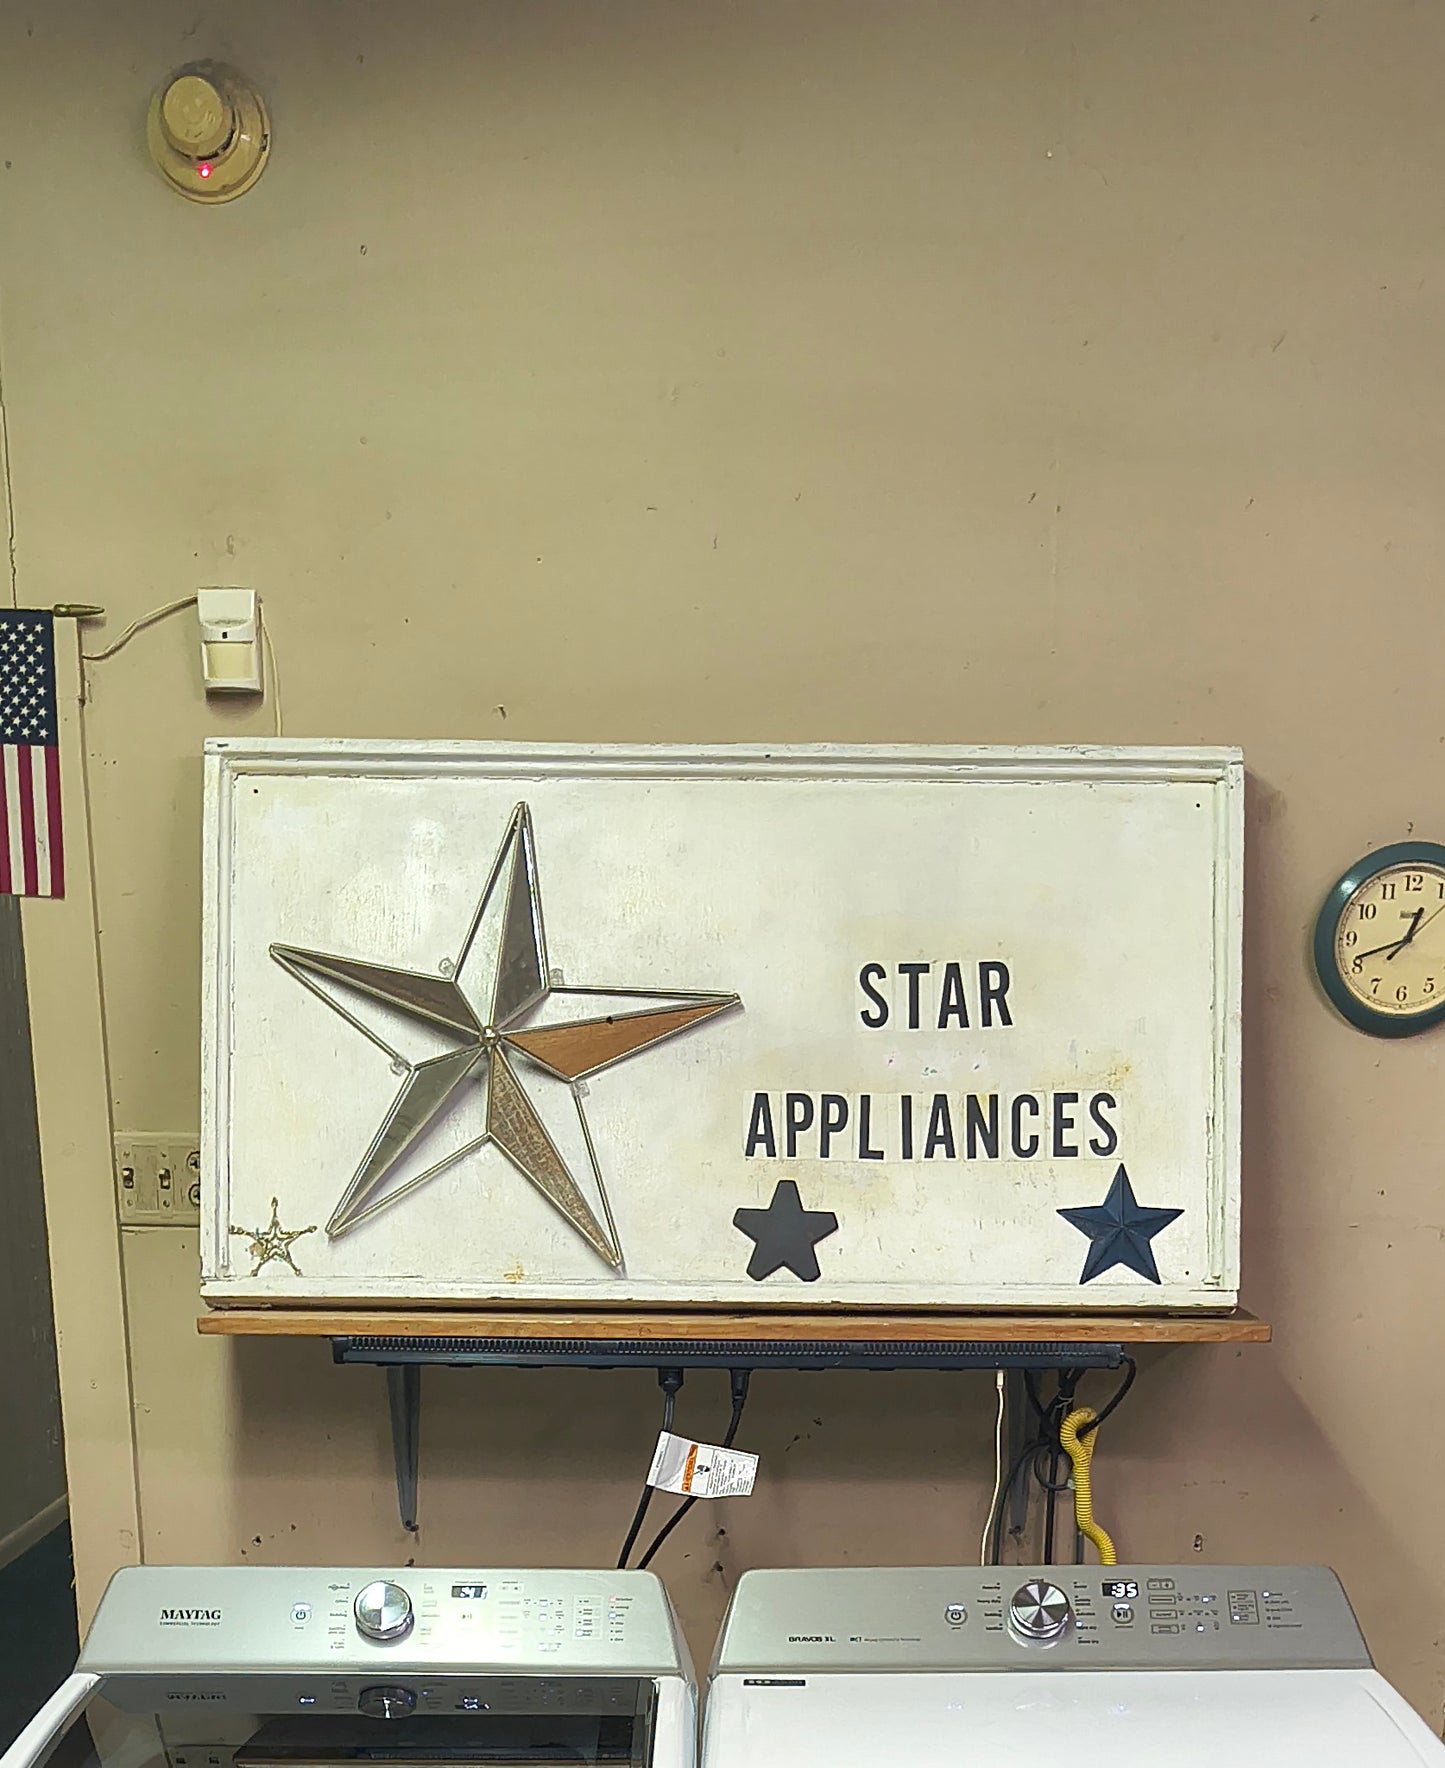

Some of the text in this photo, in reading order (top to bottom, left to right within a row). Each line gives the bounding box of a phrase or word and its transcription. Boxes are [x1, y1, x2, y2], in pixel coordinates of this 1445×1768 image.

[1381, 883, 1396, 900] 11
[1404, 875, 1424, 892] 12
[1358, 903, 1377, 920] 10
[1346, 931, 1358, 946] 9
[1351, 958, 1364, 975] 8
[1370, 977, 1384, 994] 7
[1395, 985, 1408, 1002] 6
[1423, 977, 1435, 994] 5
[859, 961, 1014, 1030] STAR
[745, 1091, 1118, 1161] APPLIANCES
[160, 1609, 221, 1620] MAYTAG
